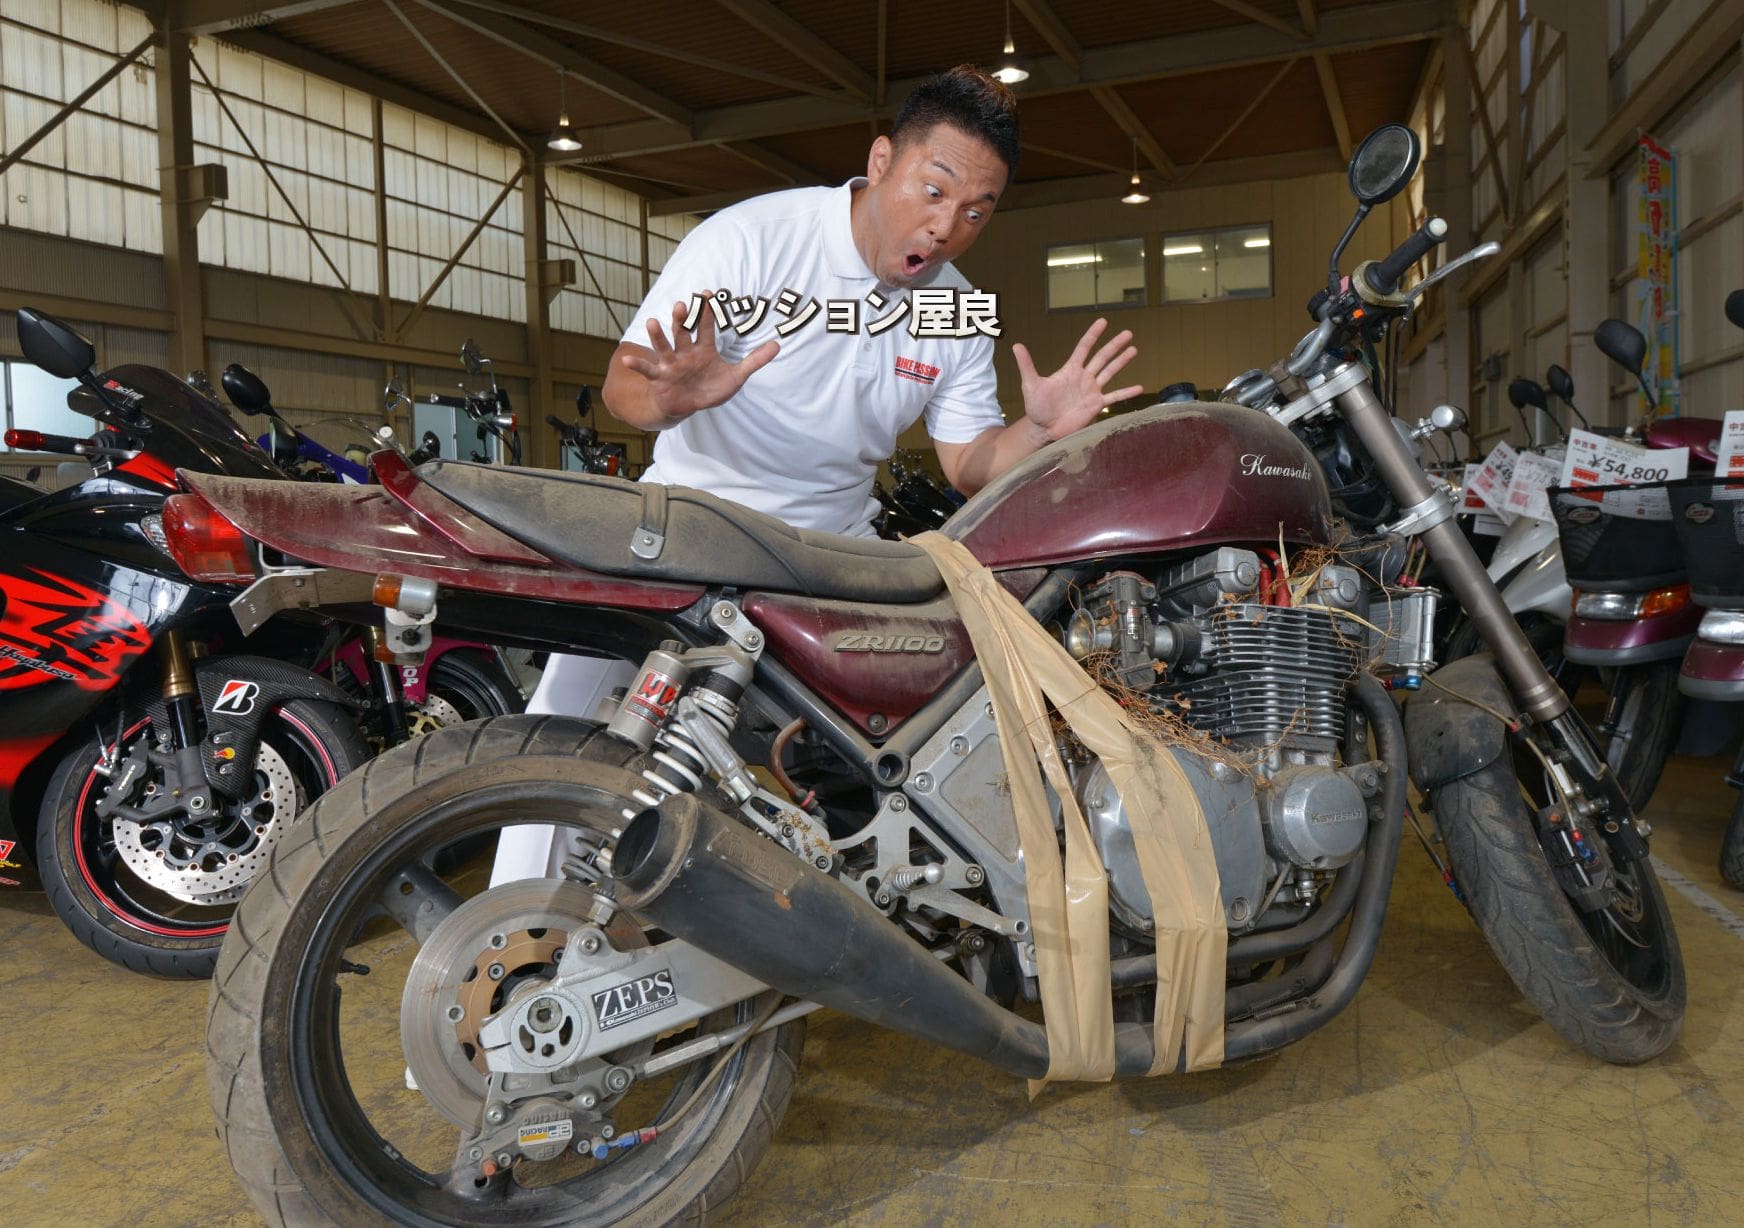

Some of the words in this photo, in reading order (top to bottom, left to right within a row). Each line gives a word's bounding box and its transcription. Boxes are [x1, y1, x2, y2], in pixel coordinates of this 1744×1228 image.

[895, 356, 914, 371] BIKE
[1240, 453, 1312, 481] Kawasaki
[1591, 454, 1669, 482] ¥54,800
[0, 644, 80, 681] Hayabusa
[402, 664, 419, 687] OP
[1311, 807, 1362, 825] Kawasaki
[594, 970, 675, 1020] ZEPS
